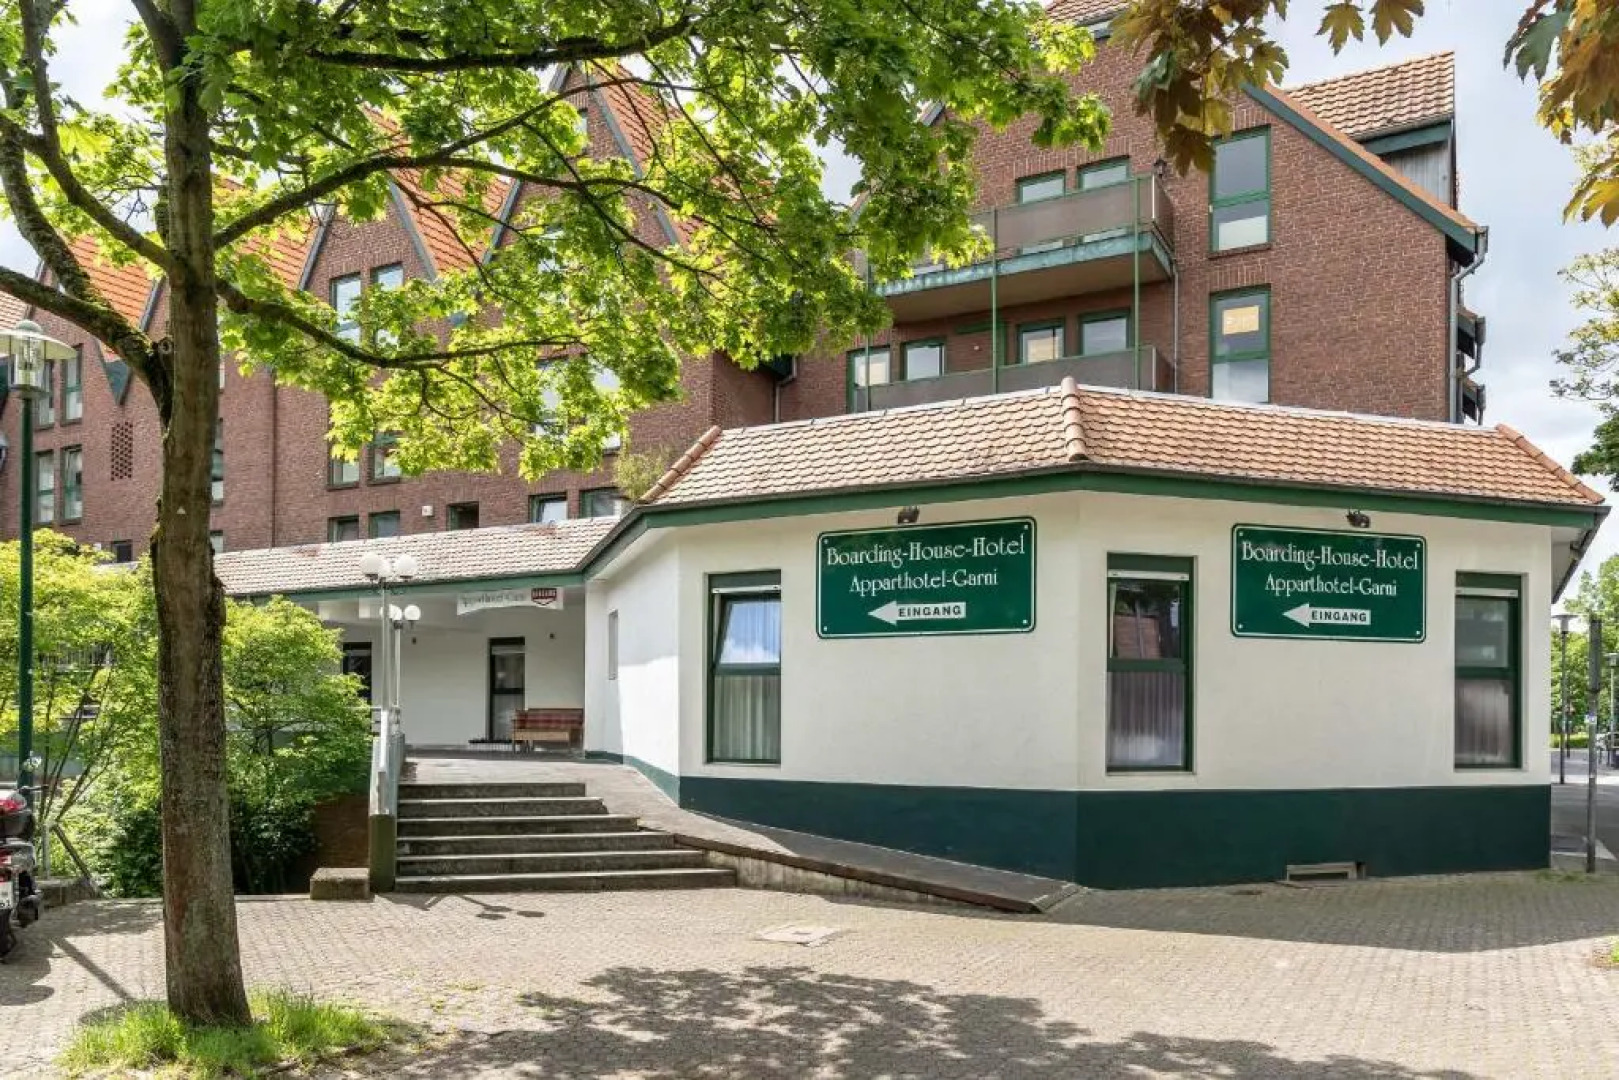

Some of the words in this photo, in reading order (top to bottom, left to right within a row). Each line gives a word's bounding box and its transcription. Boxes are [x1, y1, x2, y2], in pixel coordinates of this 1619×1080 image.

[827, 534, 1026, 568] Boarding-House-Hotel
[1242, 541, 1418, 571] Boarding-House-Hotel
[849, 569, 998, 596] Apparthotel-Garni
[1265, 573, 1397, 597] Apparthotel-Garni
[898, 604, 962, 617] EINGANG
[1311, 610, 1367, 622] EINGANG
